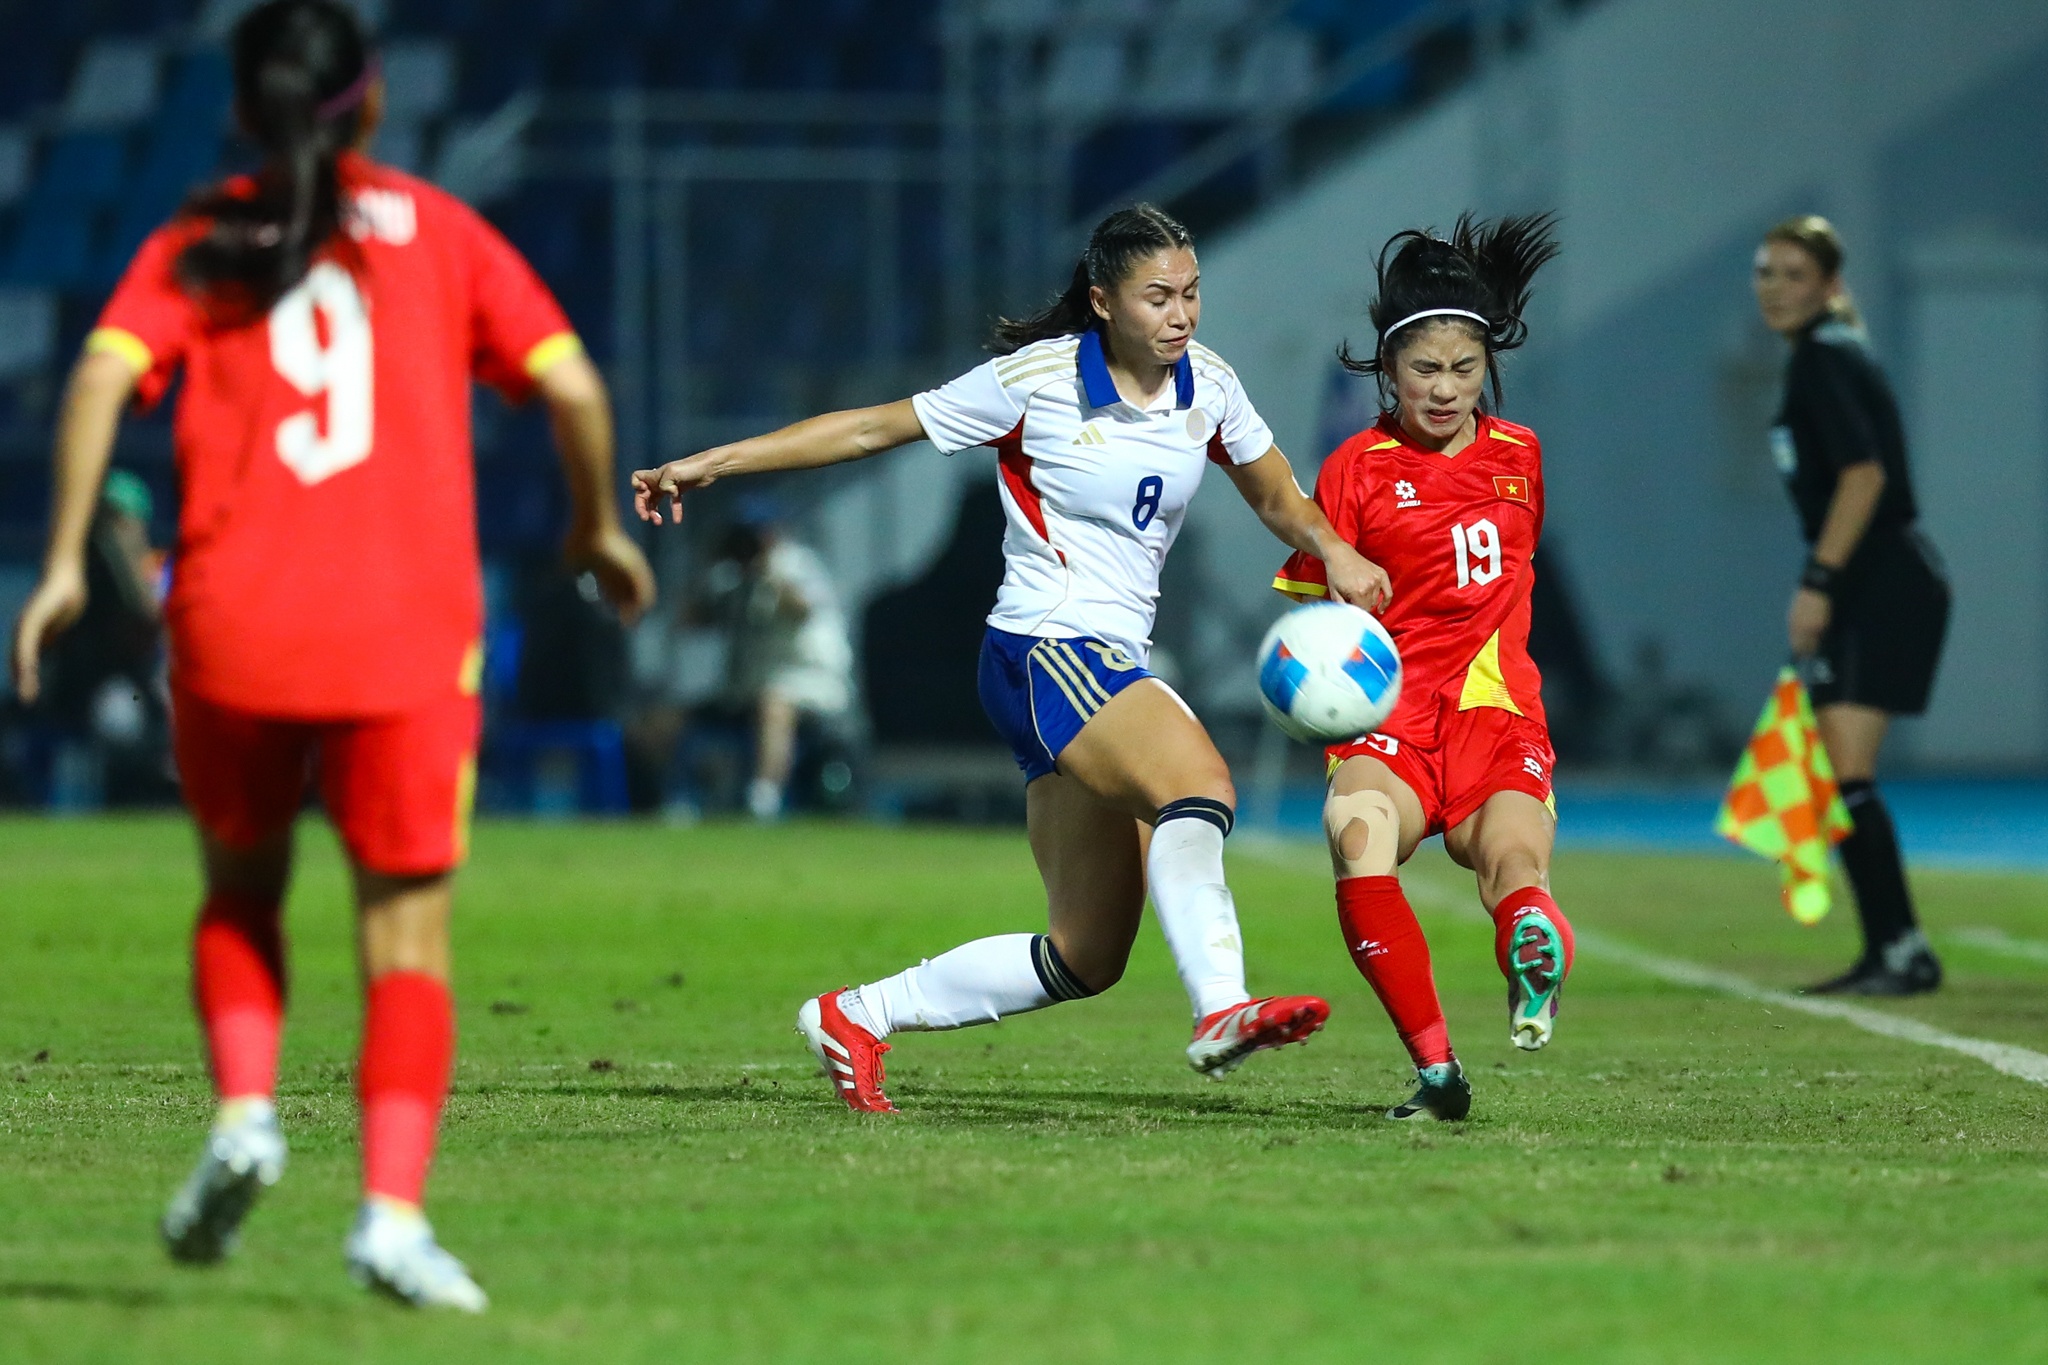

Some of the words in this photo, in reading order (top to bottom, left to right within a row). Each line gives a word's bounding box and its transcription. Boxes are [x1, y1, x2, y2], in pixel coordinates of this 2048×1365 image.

[268, 261, 374, 485] 9
[1132, 475, 1163, 531] 8
[1450, 518, 1502, 589] 19
